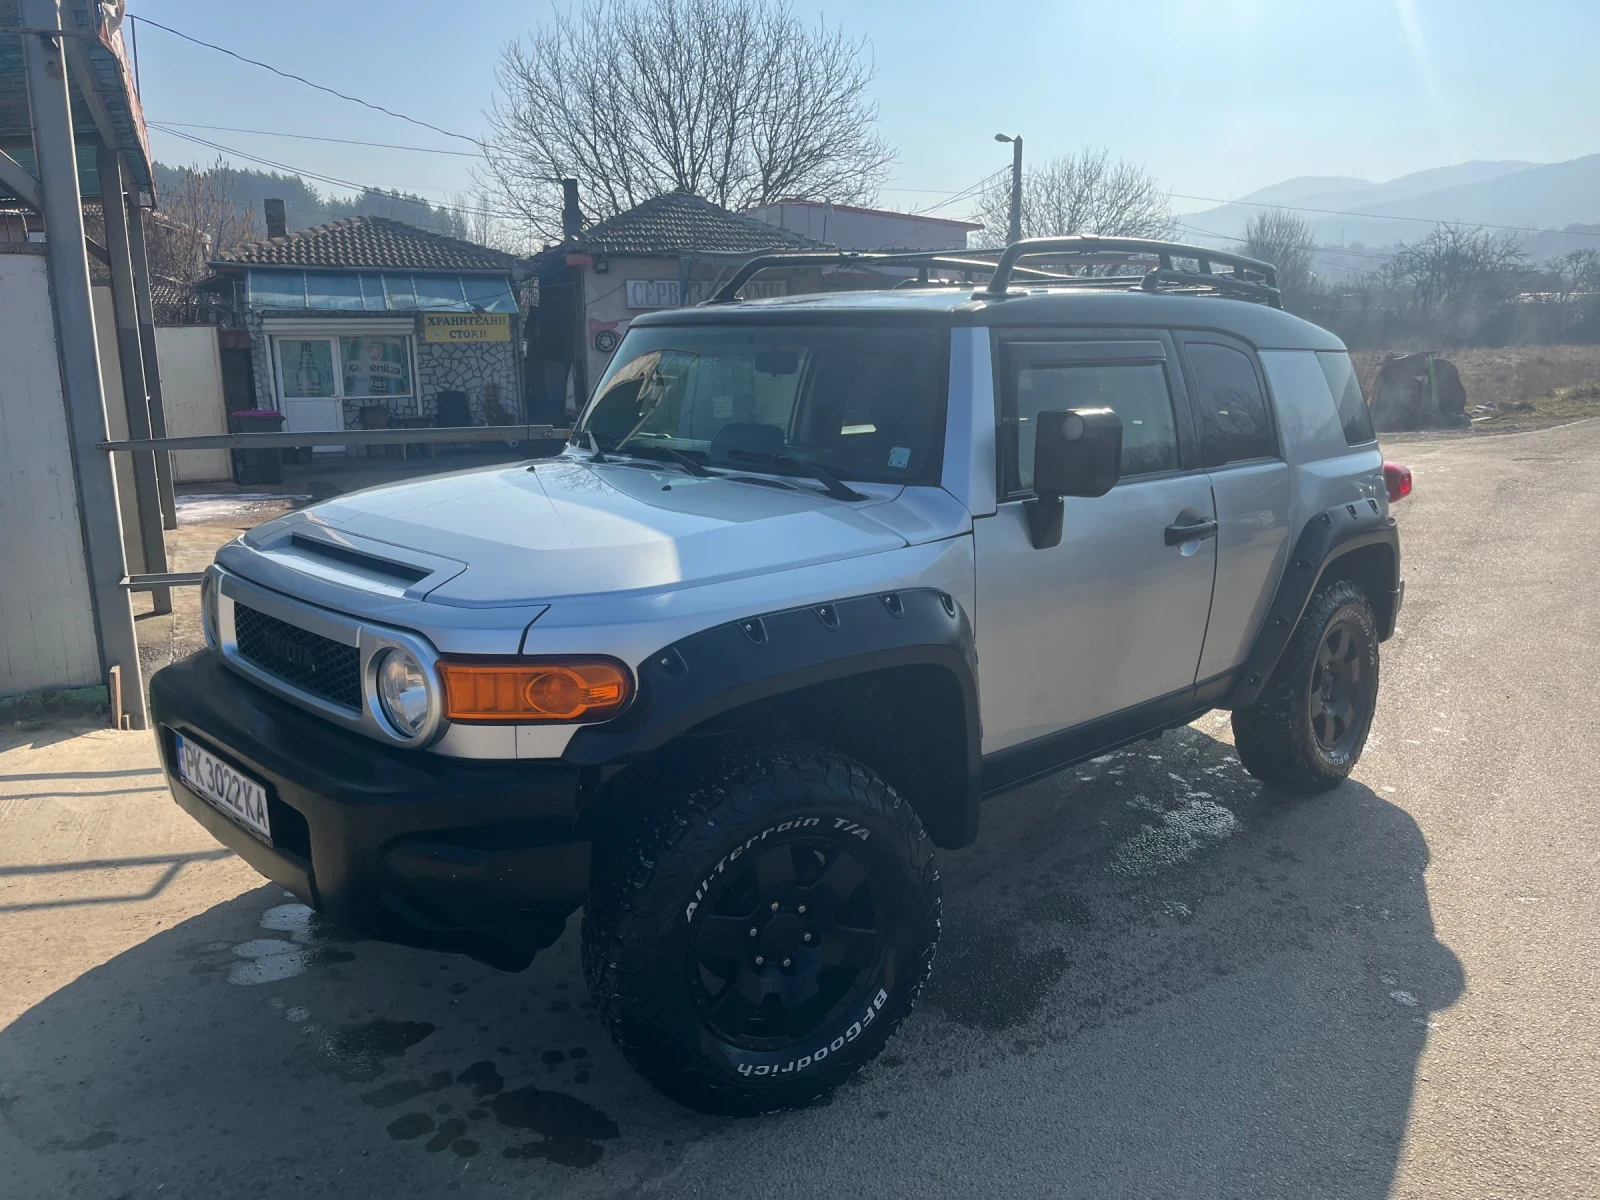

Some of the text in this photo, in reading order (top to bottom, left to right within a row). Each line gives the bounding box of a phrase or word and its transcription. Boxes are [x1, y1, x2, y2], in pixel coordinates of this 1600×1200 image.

[428, 316, 506, 326] ХРАНИТЕЛНИ
[449, 329, 487, 339] СТОКИ
[348, 363, 401, 375] Kaenitza
[205, 757, 243, 812] 3022
[685, 817, 871, 923] All-Terrain T/A
[737, 988, 888, 1077] BFGoodrich
